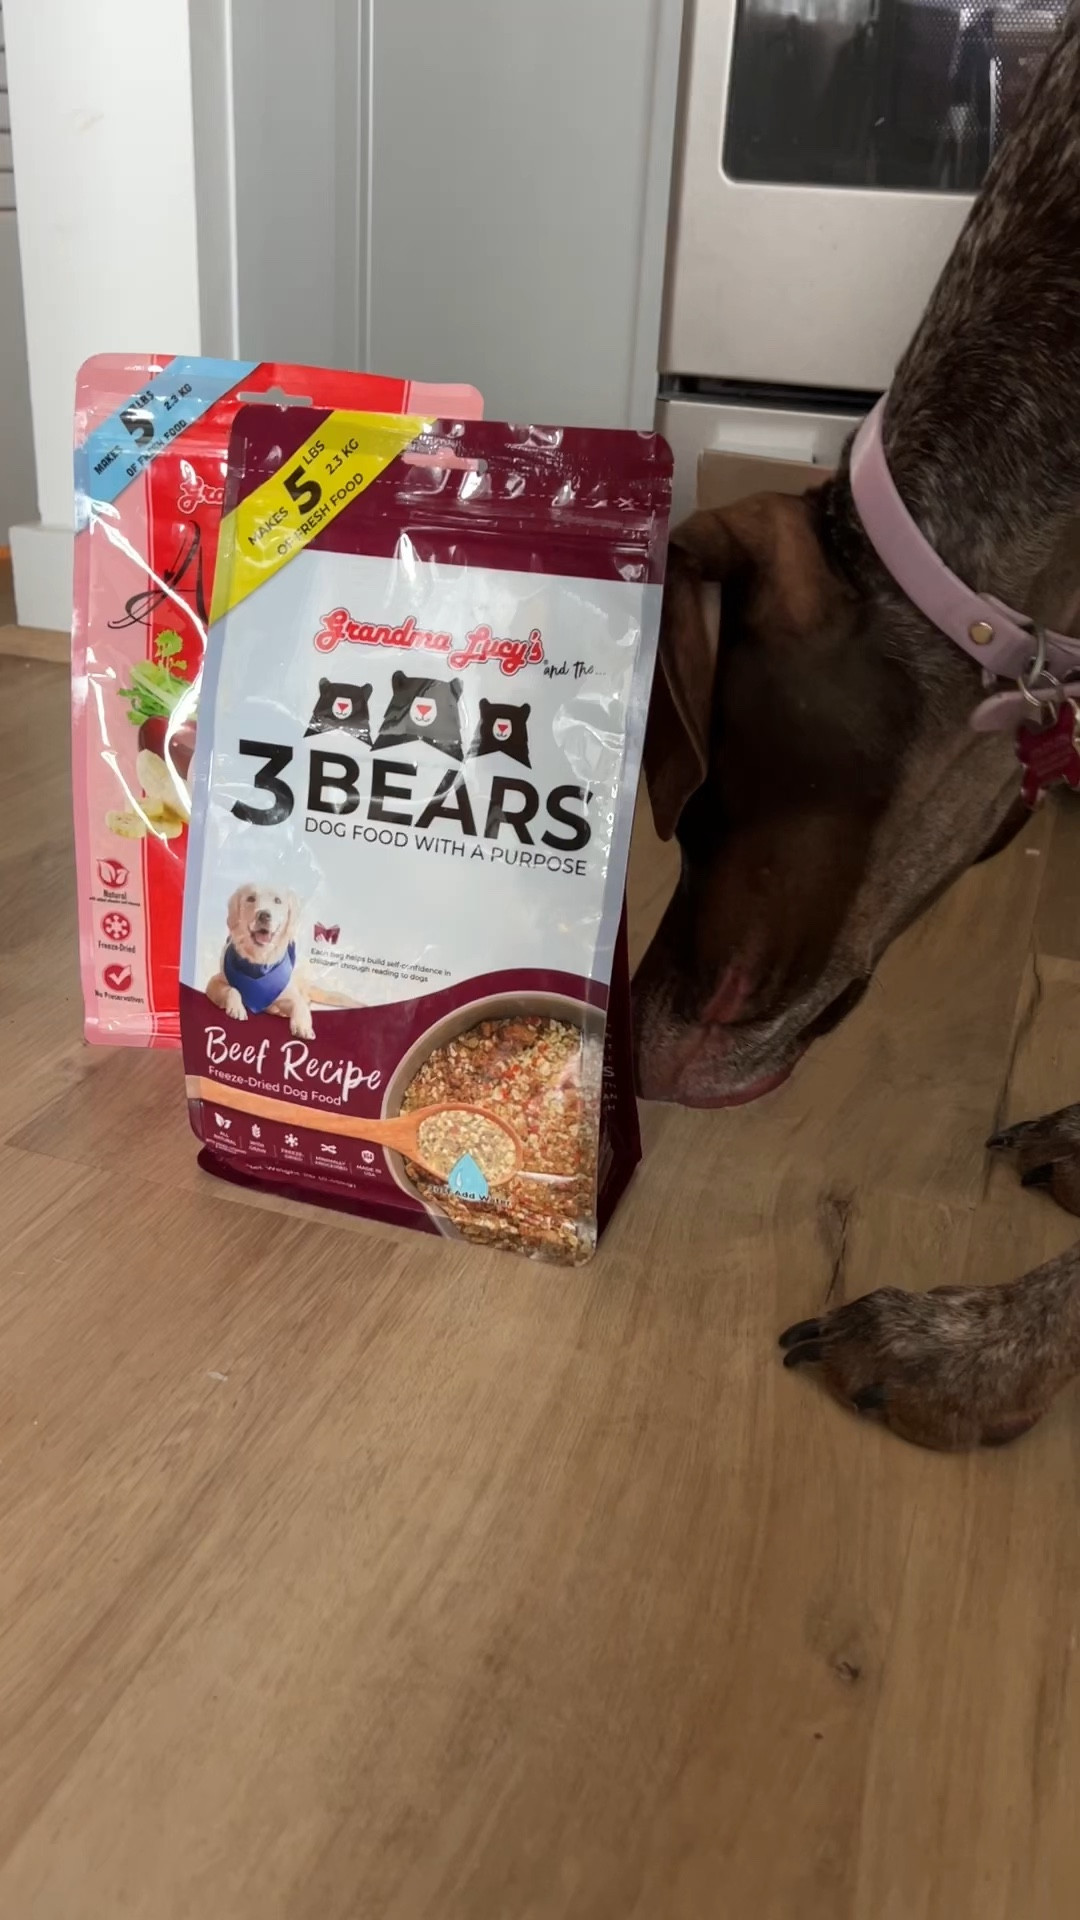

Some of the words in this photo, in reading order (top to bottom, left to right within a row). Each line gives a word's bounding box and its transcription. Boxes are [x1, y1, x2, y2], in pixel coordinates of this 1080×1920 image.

[164, 394, 179, 411] 2.3
[119, 406, 155, 448] 5
[126, 463, 137, 478] OF
[163, 419, 188, 441] FOOD
[302, 440, 325, 465] LBS
[325, 455, 343, 475] 2.3
[341, 438, 359, 458] KG
[248, 506, 289, 545] MAKES
[283, 465, 322, 515] 5
[277, 537, 293, 555] OF
[294, 504, 330, 541] FRESH
[329, 473, 364, 506] FOOD
[314, 607, 452, 653] Grandma
[448, 623, 544, 676] Lucy's
[544, 661, 569, 679] and
[230, 739, 294, 826] 3
[307, 749, 593, 852] BEARS
[304, 817, 347, 839] DOG
[352, 824, 408, 848] FOOD
[415, 834, 466, 858] WITH
[470, 844, 485, 861] A
[491, 847, 587, 876] PURPOSE
[98, 940, 136, 953] Freeze-Dried
[367, 957, 386, 966] build
[371, 967, 399, 979] reading
[410, 974, 429, 983] dogs
[204, 1025, 270, 1074] Beef
[280, 1040, 381, 1102] Recipe
[208, 1065, 280, 1093] Freeze-Dried
[283, 1084, 308, 1101] Dog
[311, 1091, 341, 1106] Food
[454, 1190, 476, 1200] Add
[479, 1194, 511, 1207] Wter
